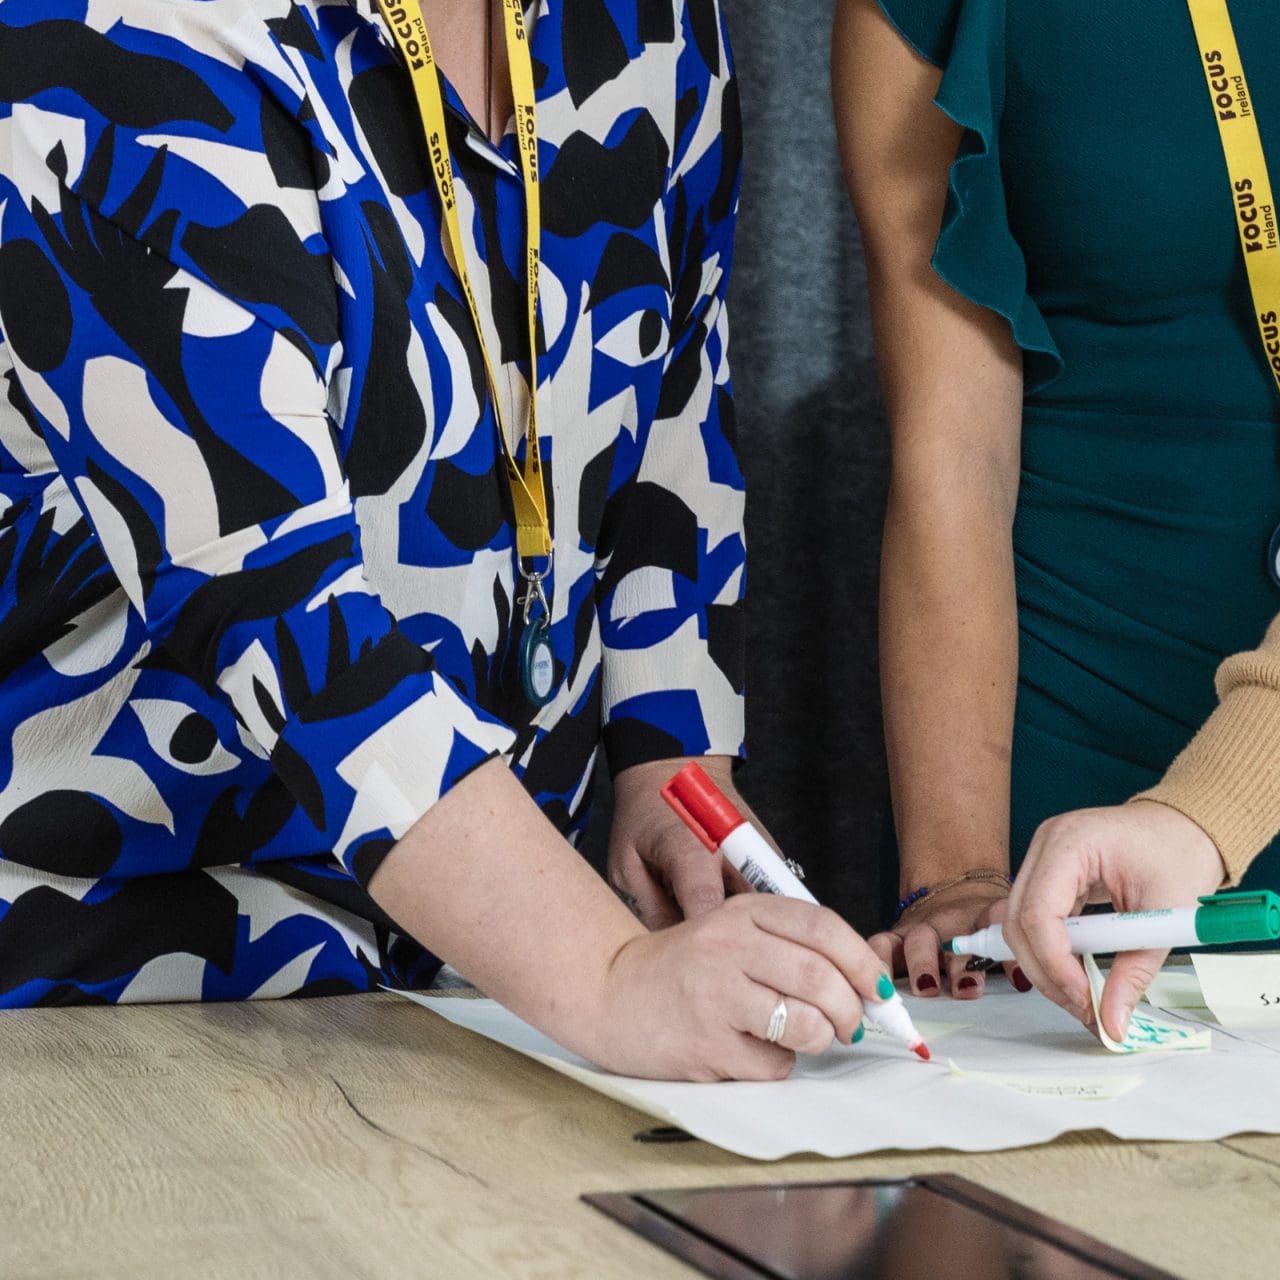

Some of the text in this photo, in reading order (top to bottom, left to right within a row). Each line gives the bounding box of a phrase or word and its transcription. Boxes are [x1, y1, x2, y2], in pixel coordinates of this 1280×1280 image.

[413, 17, 432, 65] Ireland
[1205, 50, 1237, 121] FOCUS
[1231, 75, 1251, 118] Ireland
[517, 104, 527, 150] Ireland
[525, 105, 537, 183] FOCUS
[430, 131, 453, 211] FOCUS
[1234, 178, 1264, 254] FOCUS
[1259, 204, 1277, 249] Ireland
